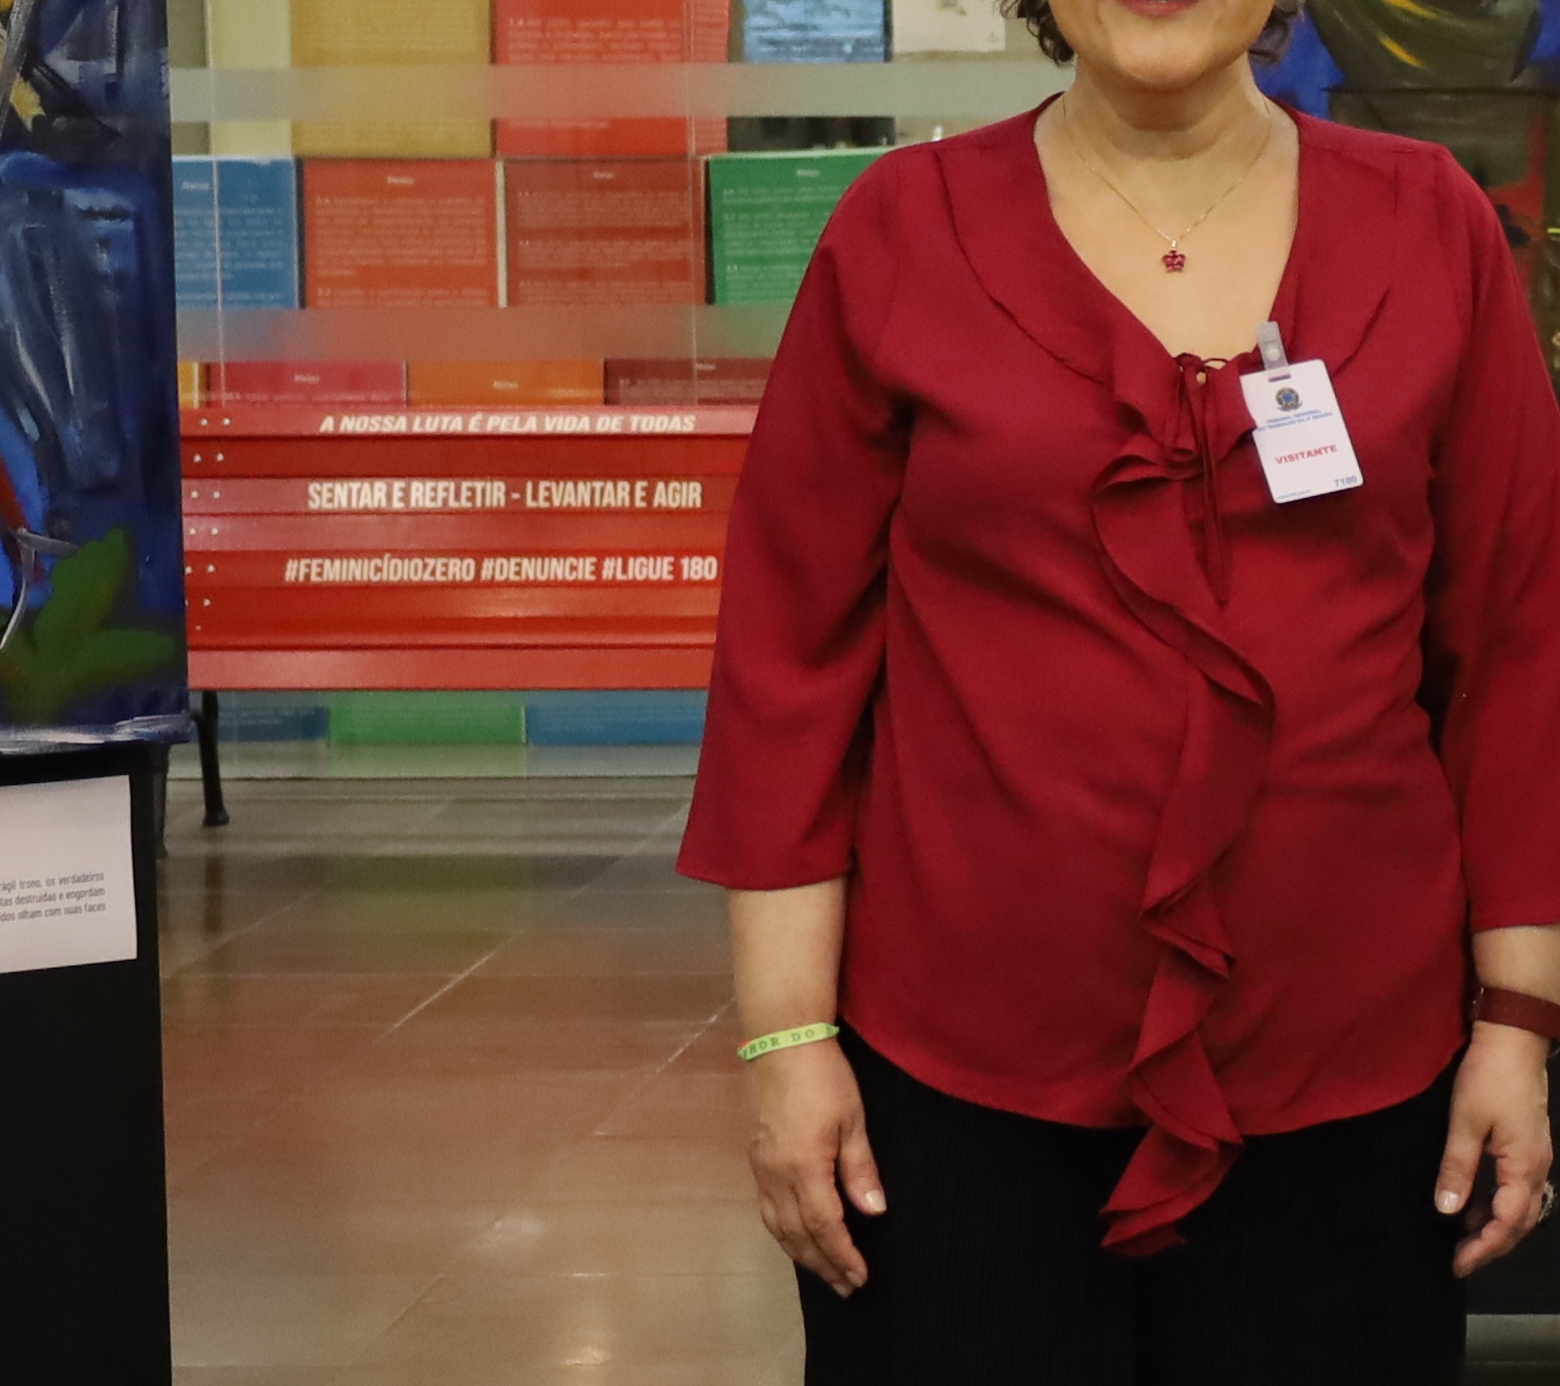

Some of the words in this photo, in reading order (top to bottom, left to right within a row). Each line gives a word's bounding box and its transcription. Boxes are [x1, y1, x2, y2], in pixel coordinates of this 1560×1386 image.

[320, 415, 334, 432] A
[340, 416, 406, 432] NOSSA
[412, 415, 463, 432] LUTA
[468, 412, 484, 432] É
[486, 415, 537, 432] PELA
[543, 415, 590, 432] VIDA
[596, 415, 624, 431] DE
[630, 415, 696, 432] TODAS
[1275, 444, 1337, 464] VISITANTE
[308, 480, 387, 509] SENTAR
[392, 481, 405, 508] E
[410, 481, 506, 508] REFLETIR
[525, 480, 630, 508] LEVANTAR
[635, 480, 648, 508] E
[653, 480, 702, 508] AGIR
[285, 553, 475, 582] #FEMINICÍDIOZERO
[481, 556, 596, 581] #DENUNCIE
[602, 556, 674, 581] #LIGUE
[680, 556, 718, 581] 180
[58, 872, 105, 885] verdadeiros
[65, 887, 105, 901] engordam
[44, 907, 62, 917] com
[63, 905, 83, 915] suas
[83, 902, 106, 913] faces
[790, 1029, 815, 1042] DO
